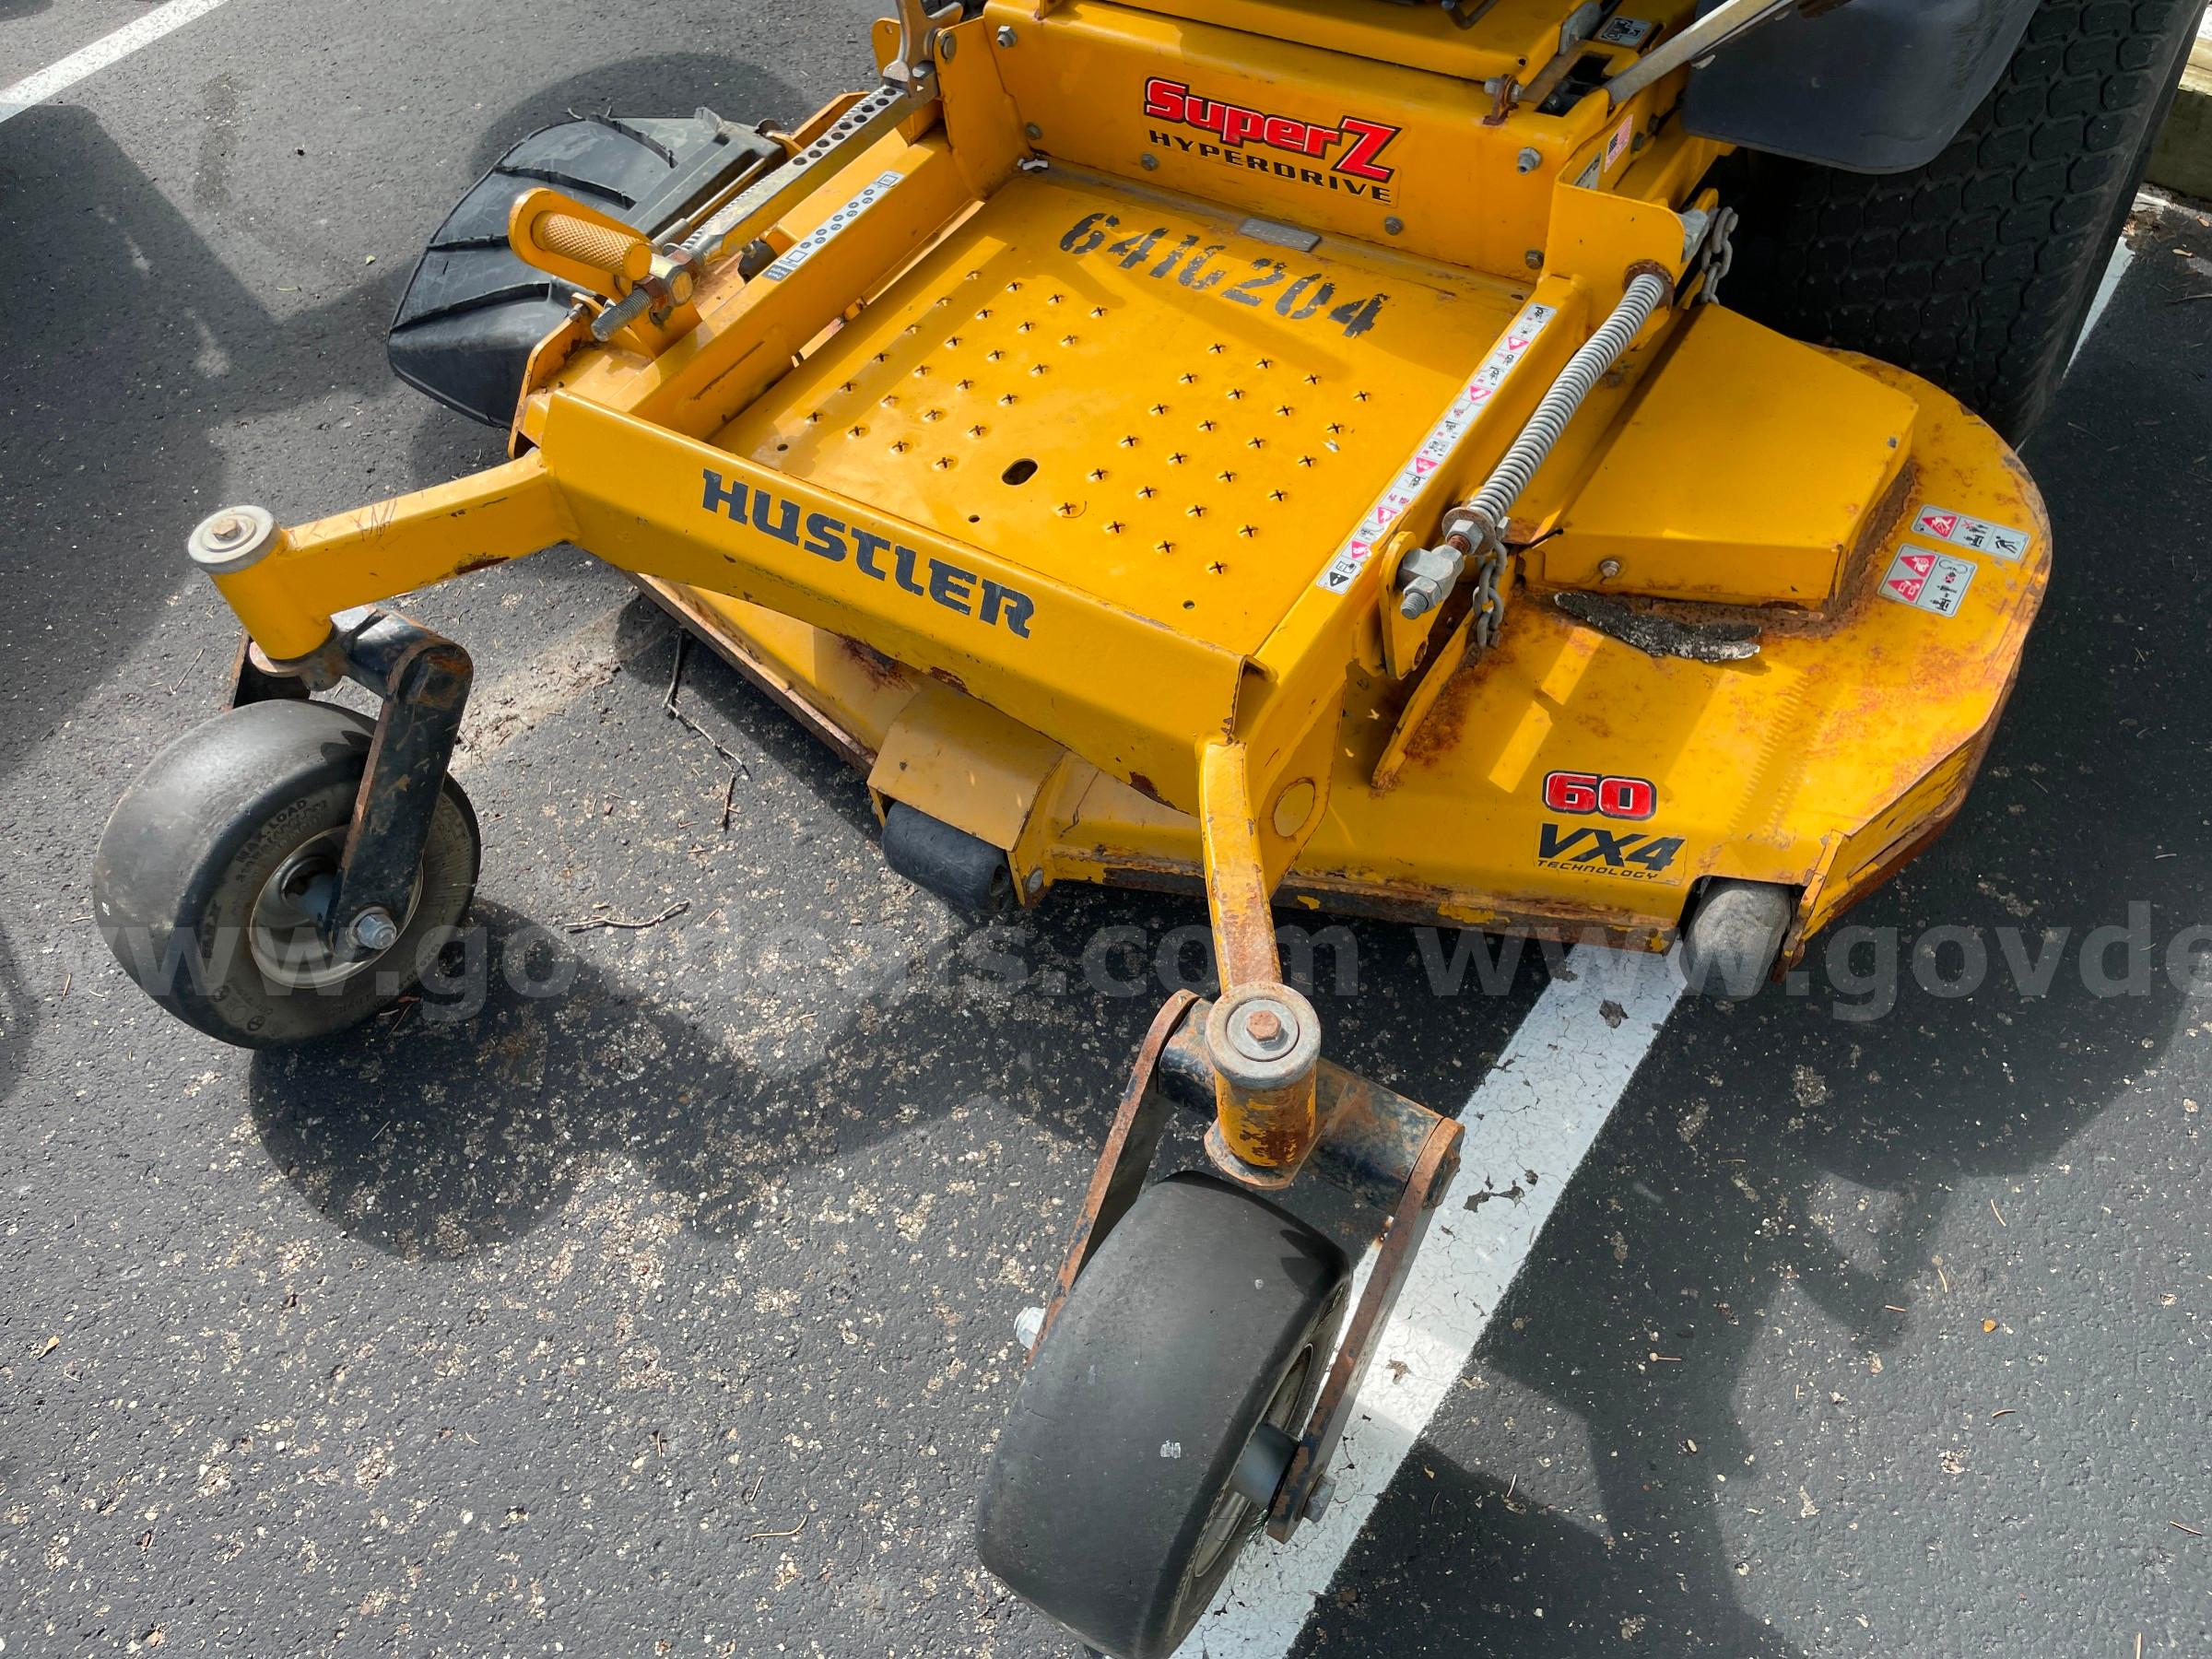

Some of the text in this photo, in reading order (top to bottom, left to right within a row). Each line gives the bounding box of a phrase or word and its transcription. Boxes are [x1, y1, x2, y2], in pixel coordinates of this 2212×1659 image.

[1149, 129, 1393, 204] HYPERDRIVE
[702, 468, 1034, 639] HUSTLER
[1542, 770, 1657, 821] 60
[1537, 859, 1659, 880] TECHNOLOGY
[1538, 822, 1686, 872] VX4
